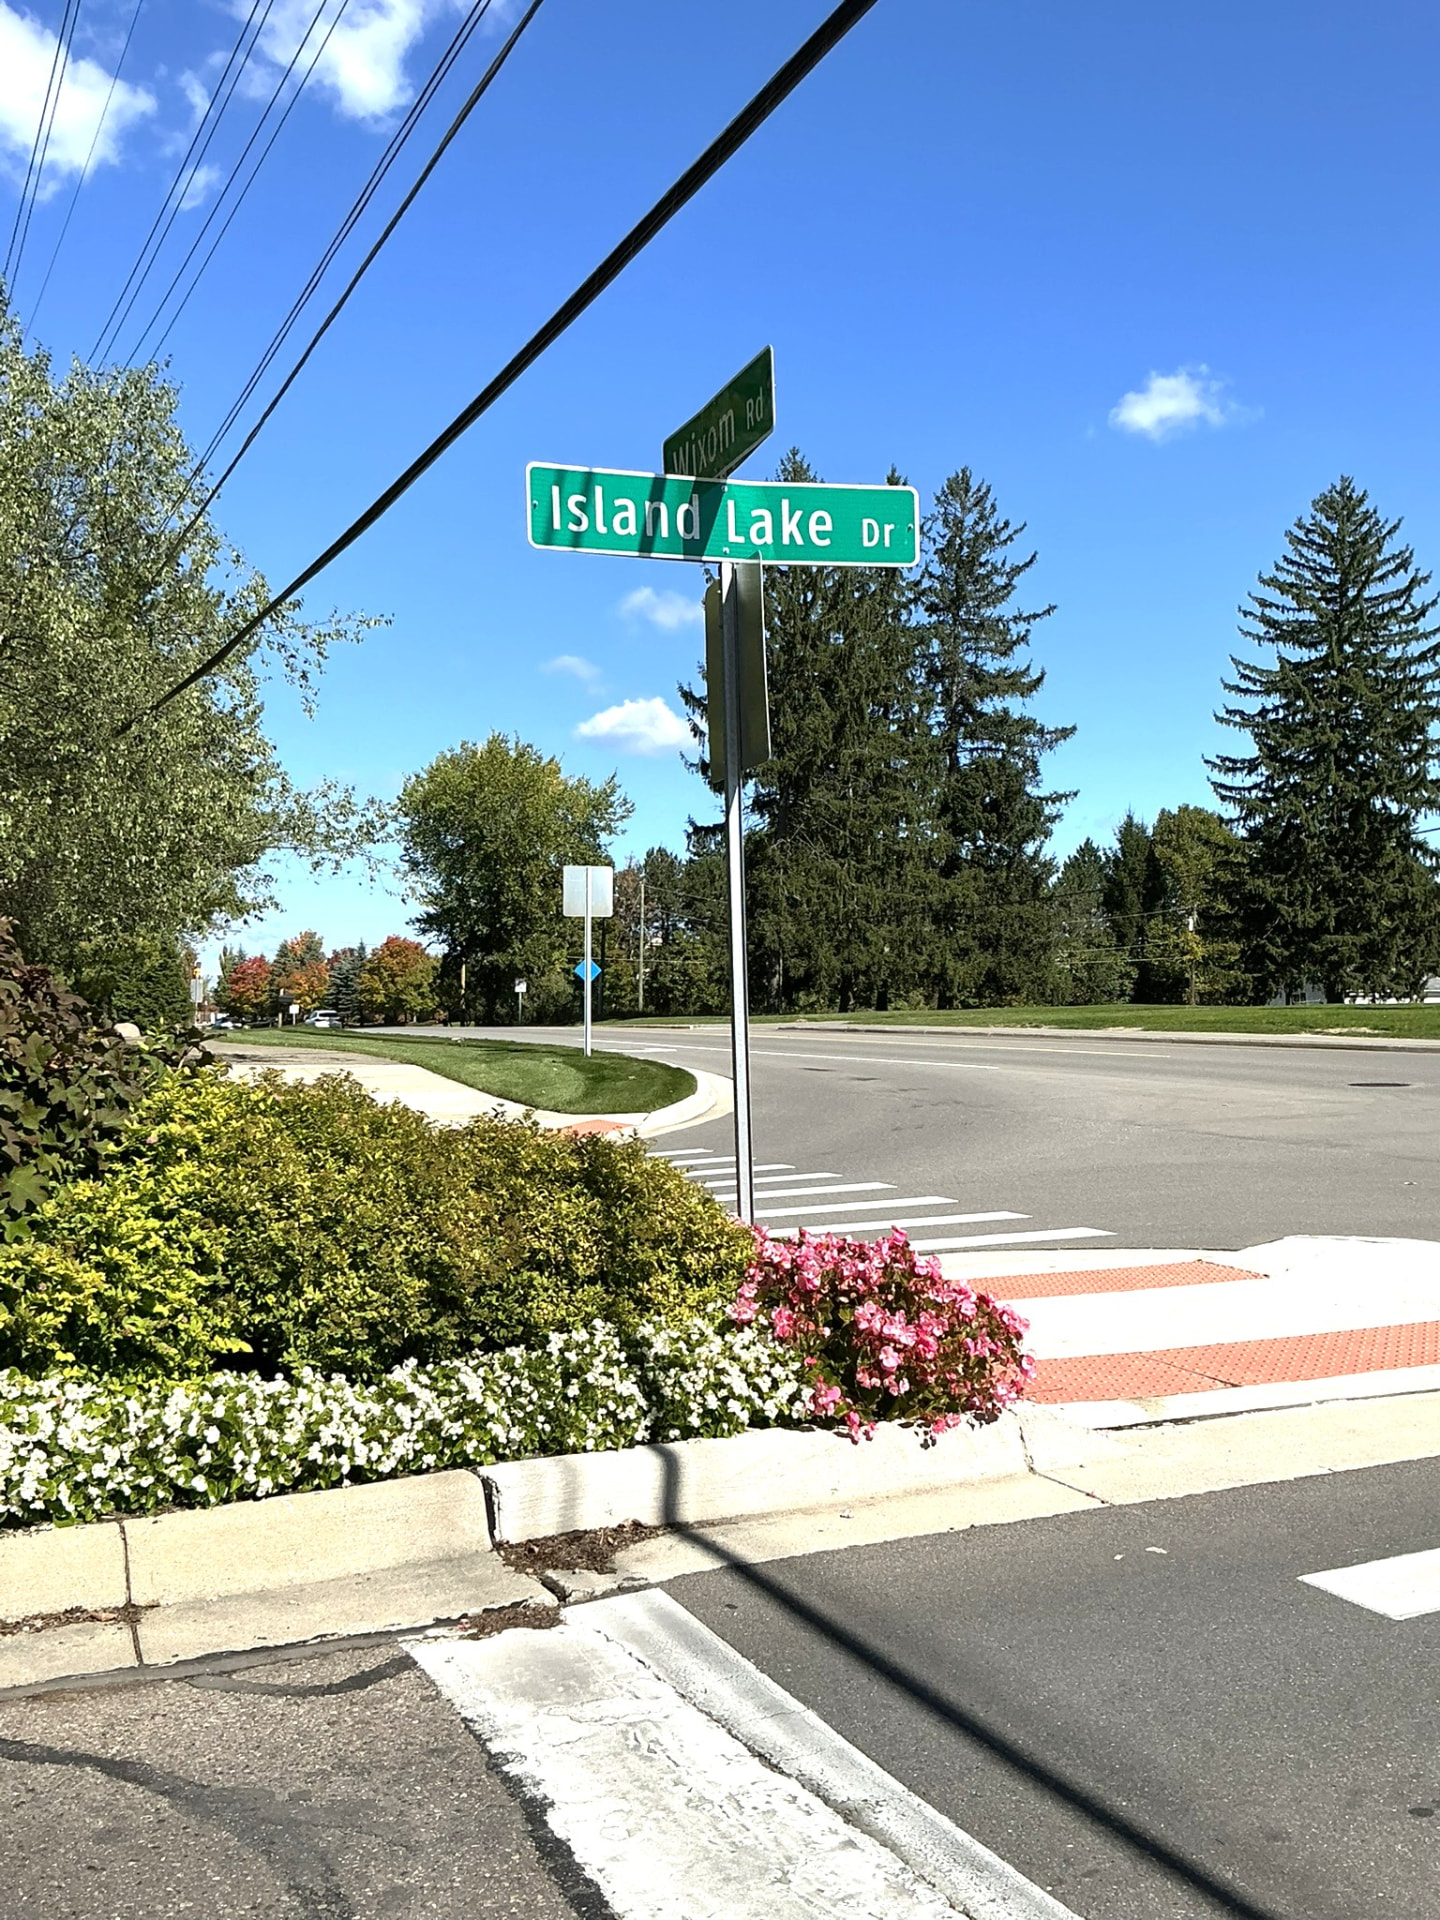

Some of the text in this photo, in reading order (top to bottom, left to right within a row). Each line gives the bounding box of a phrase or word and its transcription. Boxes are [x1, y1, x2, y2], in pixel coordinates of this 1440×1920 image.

[673, 386, 764, 476] Wixom Rd
[551, 484, 895, 548] Island Lake Dr
